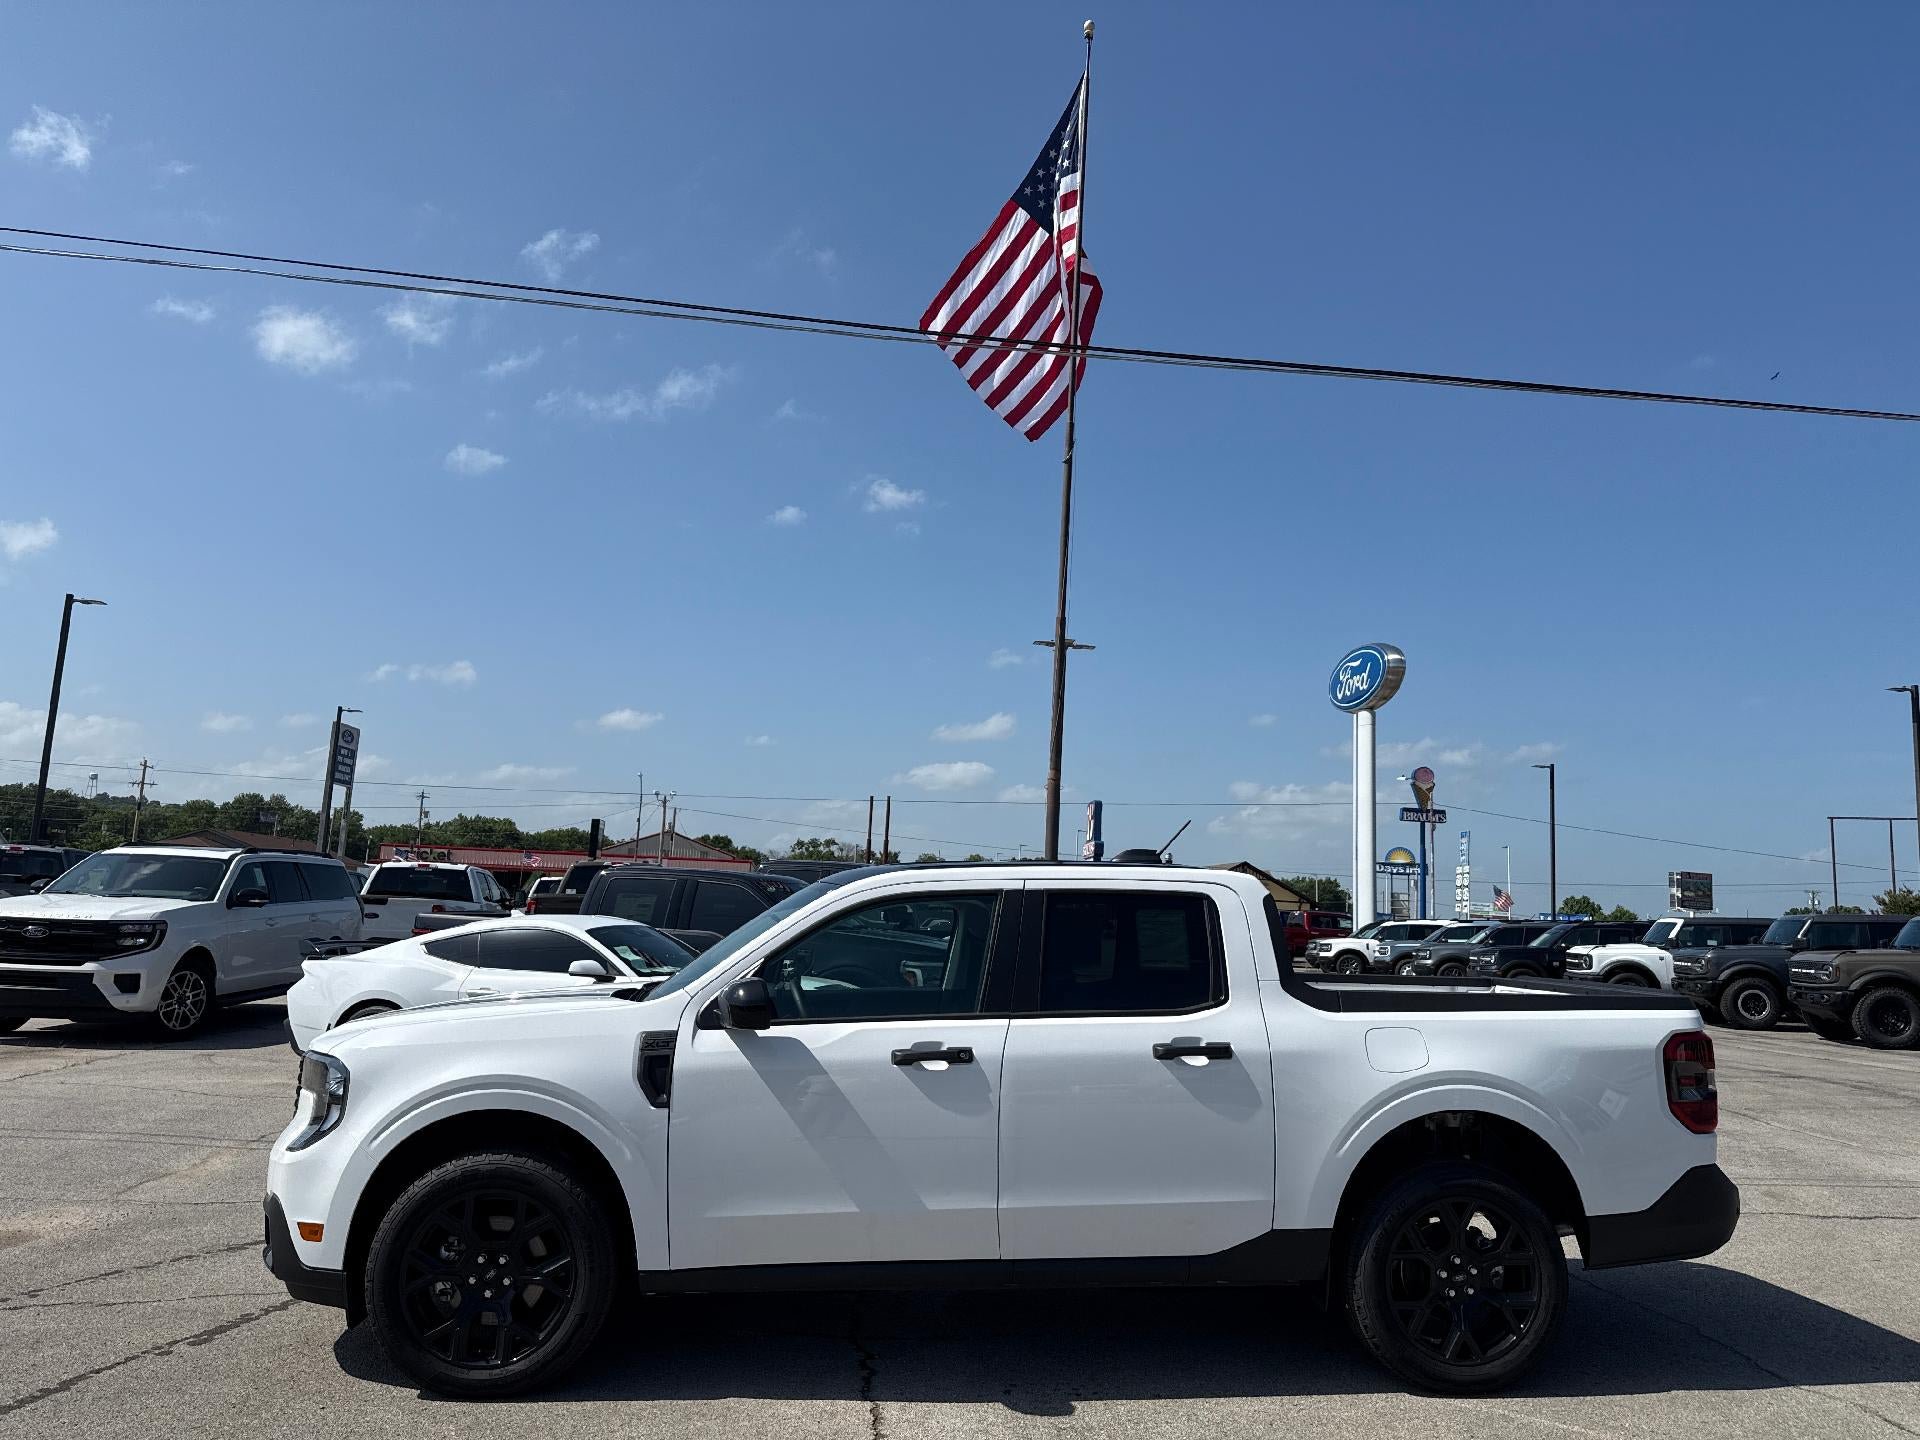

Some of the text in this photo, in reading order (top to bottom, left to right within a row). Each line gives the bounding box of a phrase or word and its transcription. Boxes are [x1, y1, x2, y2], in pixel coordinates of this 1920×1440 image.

[1337, 658, 1371, 699] Ford
[1376, 864, 1405, 873] Days
[644, 1040, 674, 1049] XLT
